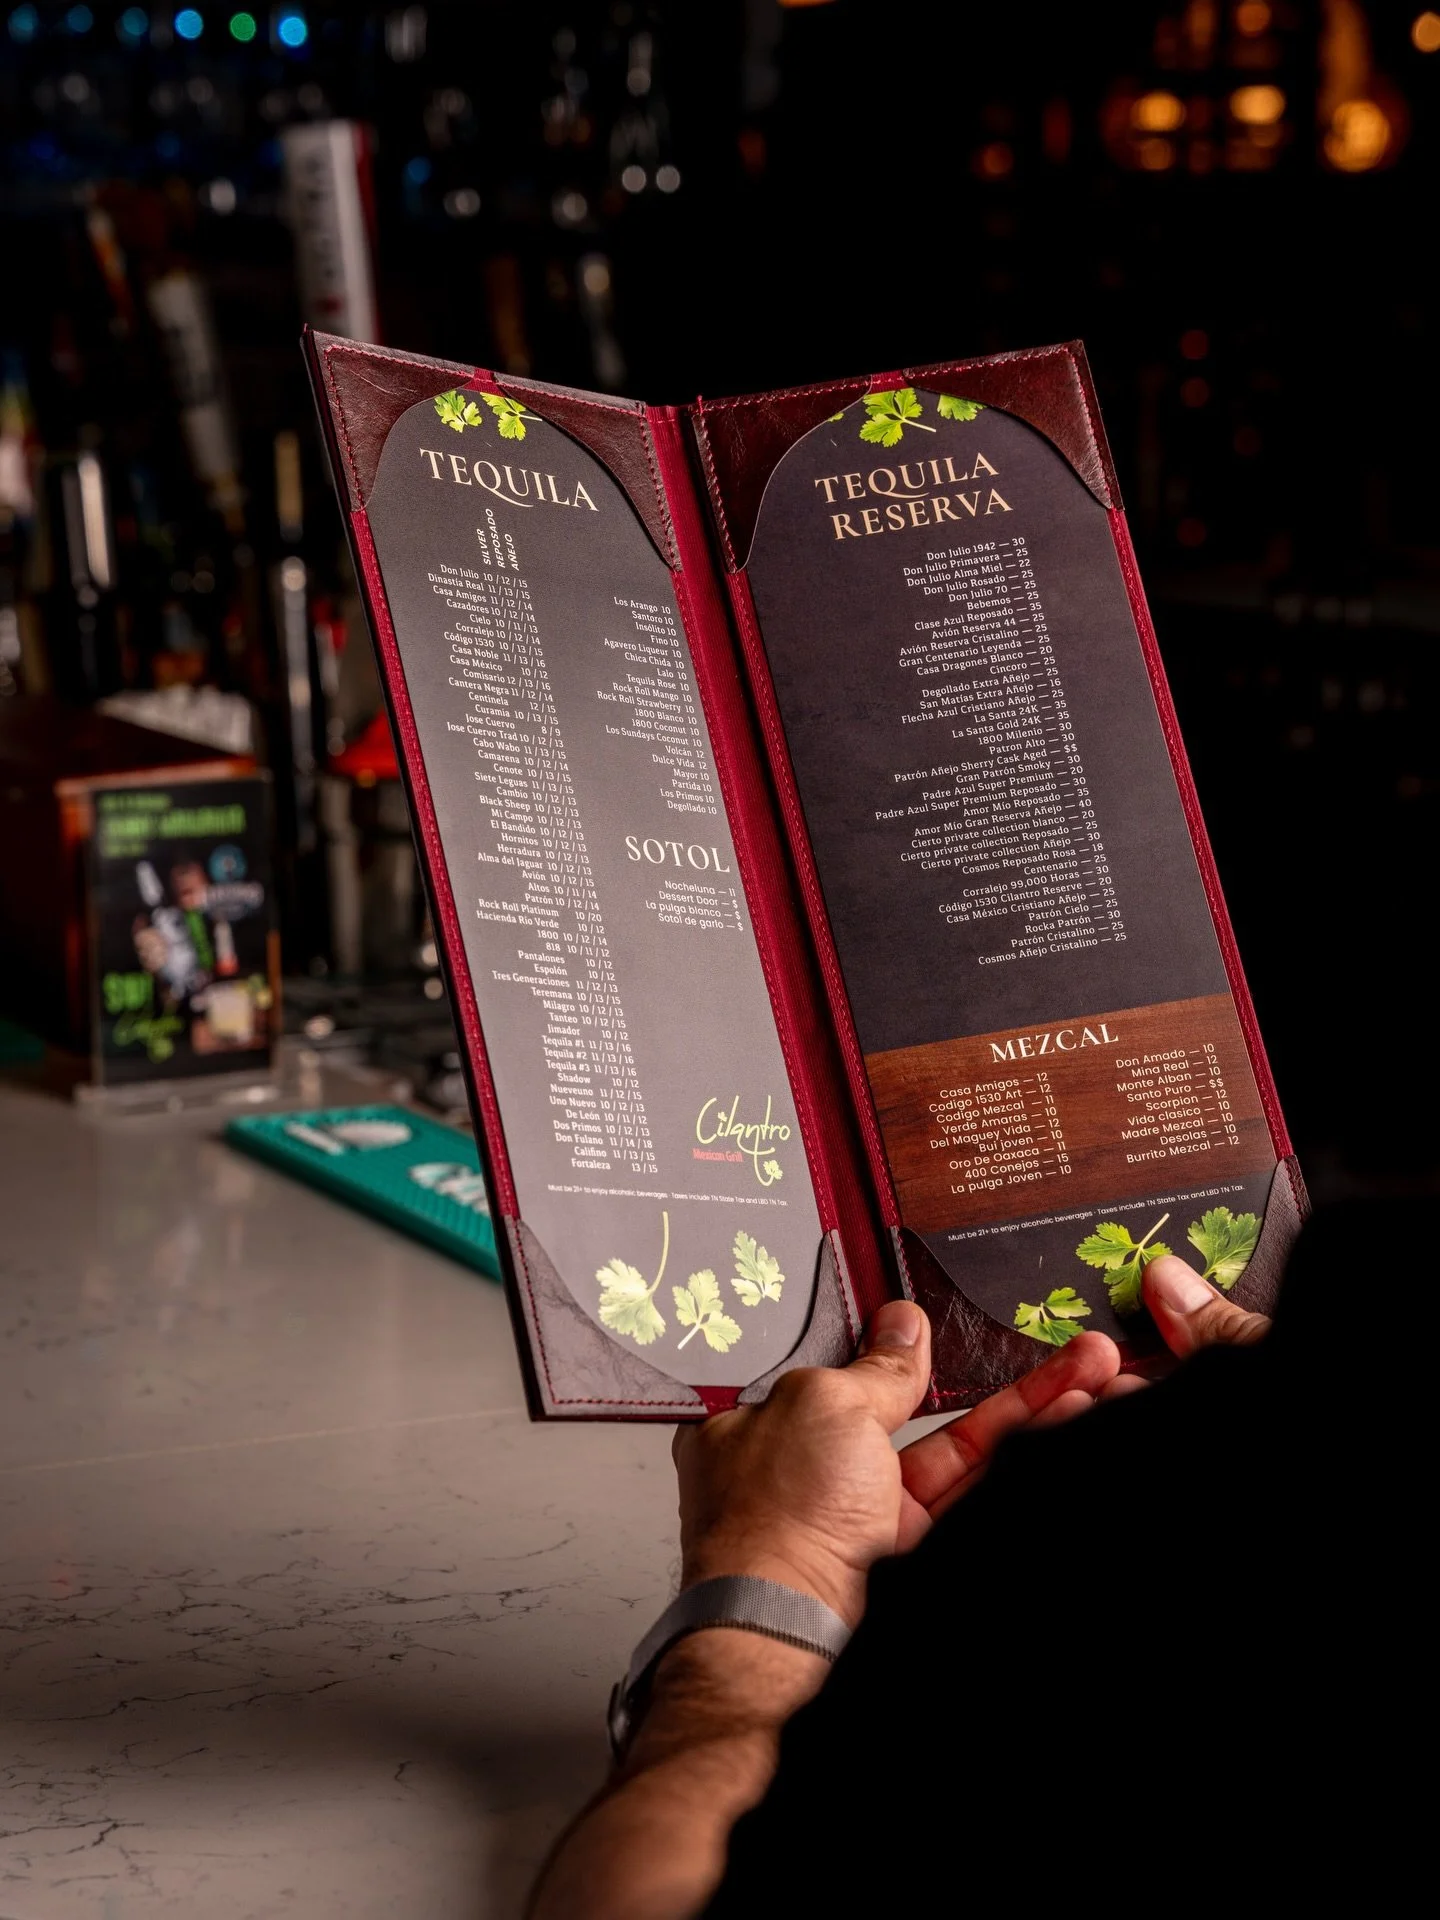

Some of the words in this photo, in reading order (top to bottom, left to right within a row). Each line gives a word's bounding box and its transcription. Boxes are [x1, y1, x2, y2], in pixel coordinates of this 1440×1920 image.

[418, 447, 599, 511] TEQUILA
[814, 452, 999, 503] TEQUILA
[829, 488, 1013, 540] RESERVA
[476, 528, 491, 565] SILVER
[485, 508, 506, 568] REPOSADO
[926, 551, 946, 561] Don
[948, 546, 971, 558] Julio
[972, 541, 996, 553] 1942
[1011, 536, 1025, 546] 30
[504, 533, 519, 571] AÑEJO
[902, 567, 923, 576] Don
[924, 561, 947, 573] Julio
[949, 553, 1000, 568] Primavera
[1015, 547, 1028, 557] 25
[439, 563, 458, 575] Don
[459, 567, 479, 579] Julio
[482, 572, 493, 582] 10
[500, 575, 510, 585] 12
[517, 578, 528, 588] 15
[432, 584, 453, 596] Casa
[455, 589, 487, 603] Amigos
[613, 596, 628, 606] Los
[630, 599, 658, 613] Arango
[660, 605, 671, 614] 10
[966, 596, 1011, 610] Bebemos
[1026, 590, 1039, 600] 25
[631, 610, 663, 623] Santoro
[663, 616, 674, 625] 10
[914, 620, 941, 630] Clase
[943, 614, 965, 626] Azul
[966, 606, 1013, 622] Reposado
[1029, 601, 1042, 611] 35
[443, 631, 473, 645] Código
[474, 636, 494, 648] 1530
[451, 643, 472, 655] Casa
[473, 647, 499, 660] Noble
[603, 637, 637, 650] Agavero
[637, 643, 668, 656] Liqueur
[671, 649, 682, 658] 10
[898, 657, 923, 667] Gran
[925, 647, 979, 663] Centenario
[980, 639, 1022, 653] Leyenda
[1037, 633, 1050, 643] 25
[624, 651, 647, 663] Chica
[648, 655, 671, 667] Chida
[674, 660, 684, 669] 10
[448, 676, 482, 690] Cantera
[483, 682, 510, 695] Negra
[612, 681, 632, 693] Rock
[633, 685, 650, 696] Roll
[651, 688, 679, 702] Mango
[682, 693, 692, 702] 10
[625, 673, 655, 686] Tequila
[656, 678, 676, 689] Rose
[679, 682, 689, 691] 10
[921, 682, 970, 697] Degollado
[972, 678, 999, 689] Extra
[1002, 672, 1030, 684] Añejo
[1045, 666, 1058, 676] 25
[631, 718, 652, 729] 1800
[653, 721, 686, 734] Coconut
[689, 727, 699, 736] 10
[951, 729, 964, 738] La
[965, 725, 994, 736] Santa
[996, 718, 1019, 730] Gold
[1021, 715, 1042, 726] 24K
[1056, 710, 1069, 720] 35
[472, 737, 494, 748] Cabo
[495, 740, 520, 752] Wabo
[651, 753, 674, 765] Dulce
[675, 757, 695, 768] Vida
[698, 761, 707, 769] 12
[893, 769, 928, 782] Patrón
[930, 764, 959, 776] Añejo
[960, 759, 994, 771] Sherry
[996, 753, 1020, 764] Cask
[1022, 747, 1047, 761] Aged
[1063, 743, 1077, 753] $$
[479, 794, 503, 806] Black
[504, 798, 530, 812] Sheep
[666, 799, 706, 813] Degollado
[707, 805, 717, 815] 10
[500, 832, 538, 845] Hornitos
[900, 850, 931, 861] Cierto
[933, 844, 968, 858] private
[971, 835, 1019, 849] collection
[1021, 825, 1069, 841] Reposado
[1085, 820, 1098, 830] 25
[625, 835, 730, 872] SOTOL
[962, 883, 1008, 897] Corralejo
[1010, 875, 1047, 889] 99,000
[1049, 871, 1080, 882] Horas
[1095, 864, 1109, 874] 30
[524, 892, 553, 904] Patrón
[1024, 921, 1055, 934] Rocka
[1057, 915, 1091, 928] Patrón
[1106, 909, 1120, 919] 30
[517, 949, 565, 964] Pantalones
[977, 952, 1016, 965] Cosmos
[1019, 946, 1047, 958] Añejo
[1049, 938, 1098, 952] Cristalino
[1113, 931, 1127, 941] 25
[491, 970, 511, 981] Tres
[512, 972, 570, 987] Generaciones
[530, 986, 573, 999] Teremana
[542, 1046, 574, 1059] Tequila
[576, 1051, 587, 1060] #2
[988, 1022, 1119, 1063] MEZCAL
[939, 1087, 971, 1098] Casa
[975, 1078, 1019, 1093] Amigos
[1036, 1071, 1048, 1082] 12
[1116, 1079, 1154, 1092] Monte
[1157, 1072, 1192, 1085] Alban
[1208, 1066, 1221, 1076] 10
[552, 1119, 570, 1130] Dos
[571, 1121, 602, 1132] Primos
[929, 1136, 950, 1149] Del
[952, 1129, 999, 1145] Maguey
[1002, 1124, 1031, 1135] Vida
[1048, 1117, 1060, 1128] 12
[696, 1094, 790, 1186] Cilantro
[1126, 1149, 1166, 1163] Burrito
[1168, 1139, 1211, 1156] Mezcal
[1227, 1135, 1240, 1145] 12
[570, 1157, 611, 1170] Fortaleza
